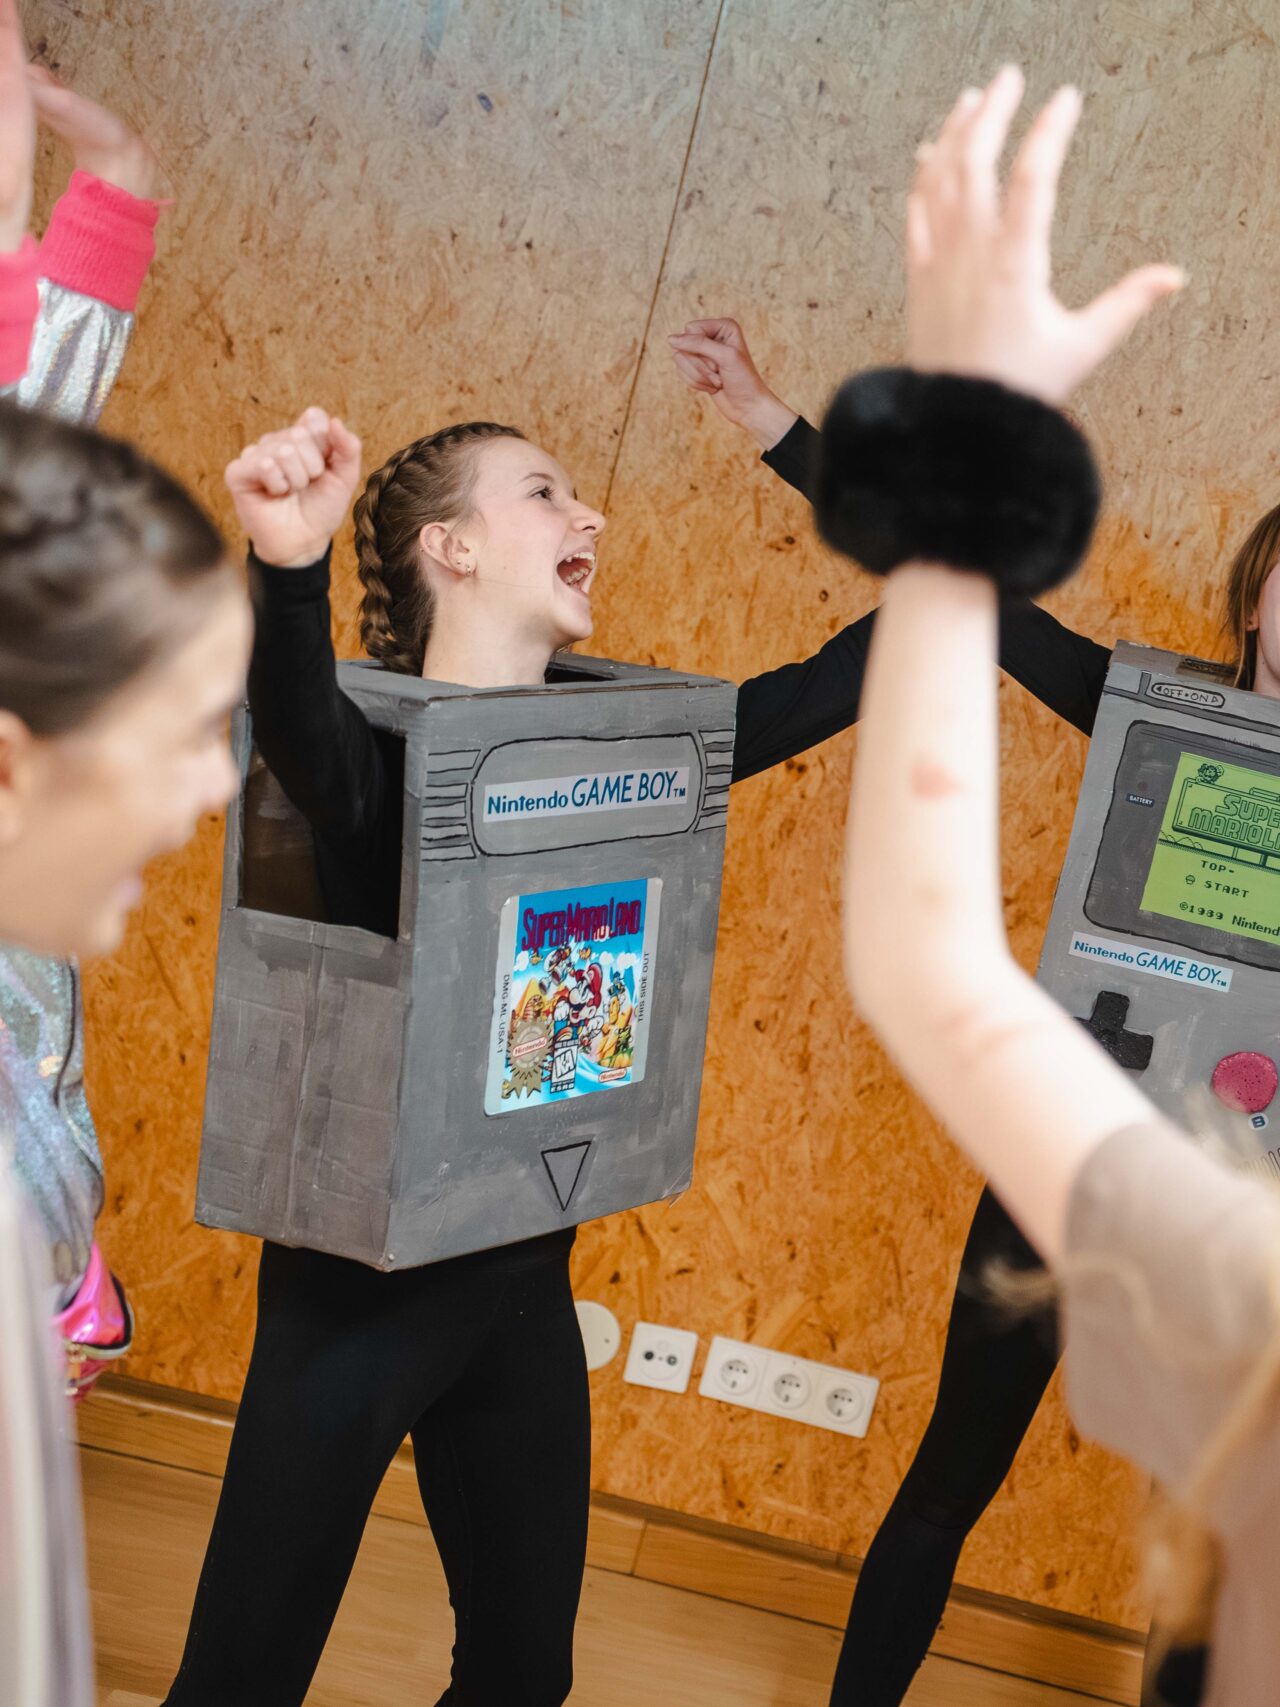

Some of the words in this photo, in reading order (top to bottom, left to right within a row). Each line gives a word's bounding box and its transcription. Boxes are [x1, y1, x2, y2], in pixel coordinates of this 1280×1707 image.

[1163, 687, 1183, 697] OFF
[1190, 693, 1208, 702] ON
[487, 790, 568, 815] Nintendo
[571, 774, 634, 807] GAME
[637, 771, 678, 801] BOY
[1129, 795, 1153, 805] BATTERY
[1188, 807, 1262, 846] MARIO
[1204, 880, 1249, 898] START
[521, 907, 567, 952] SUPER
[566, 902, 608, 944] MARIO
[608, 897, 642, 938] LAND
[642, 953, 650, 972] OUT
[1074, 940, 1134, 963] Nintendo
[1136, 952, 1187, 976] GAME
[1187, 963, 1221, 983] BOY
[640, 976, 648, 998] SIDE
[514, 1040, 546, 1056] Nintendo
[1251, 1116, 1265, 1128] B
